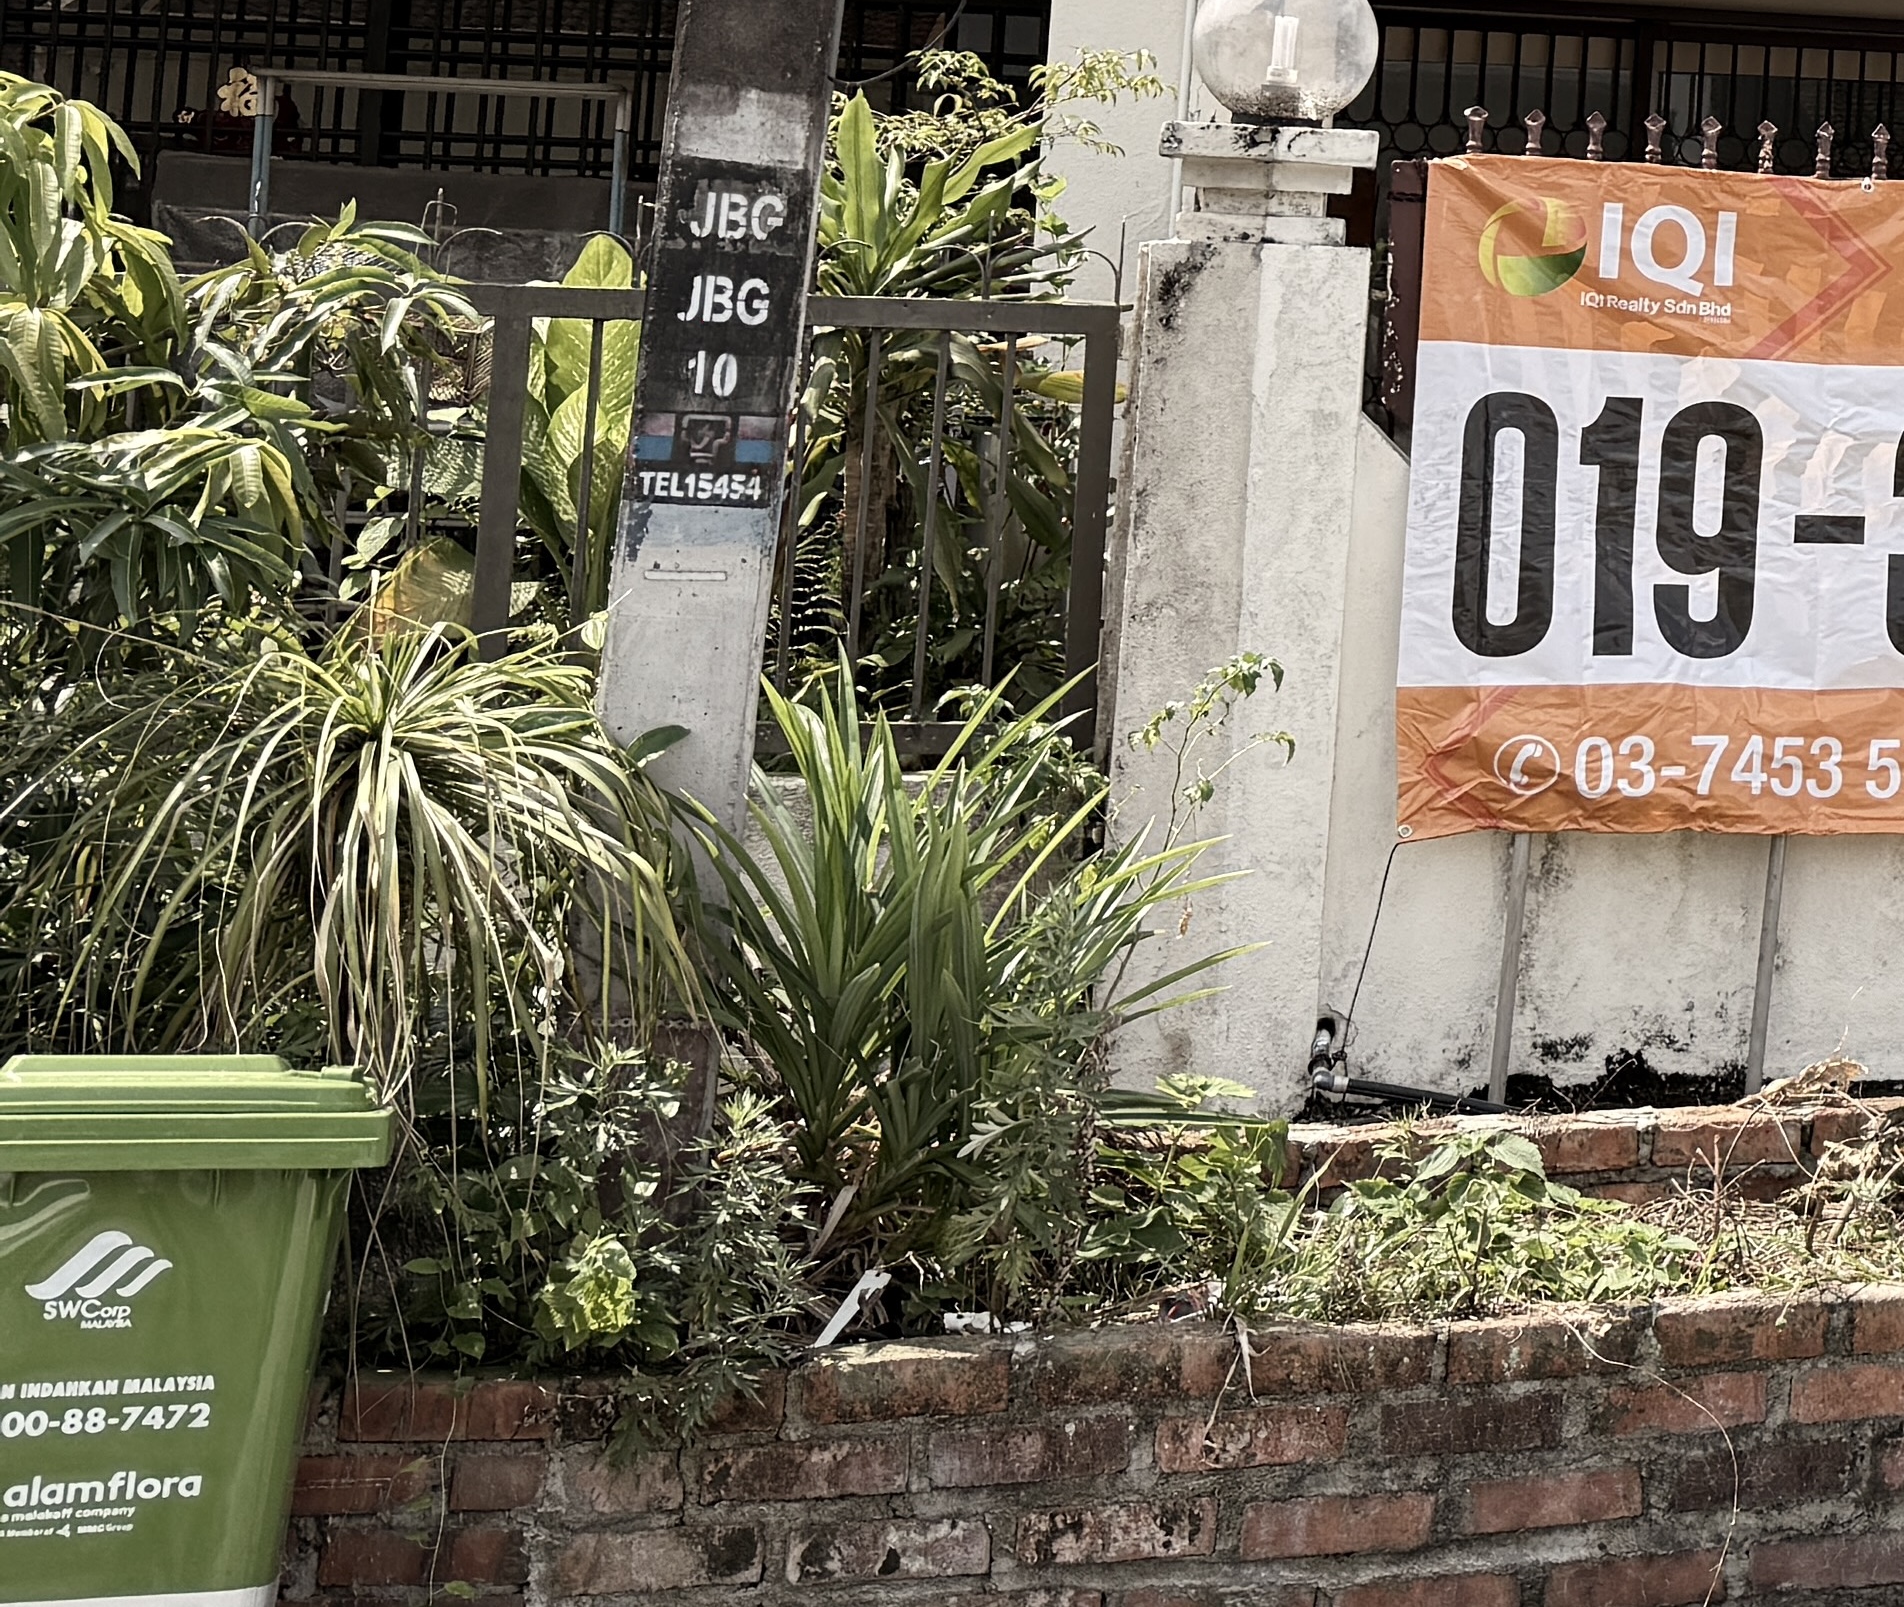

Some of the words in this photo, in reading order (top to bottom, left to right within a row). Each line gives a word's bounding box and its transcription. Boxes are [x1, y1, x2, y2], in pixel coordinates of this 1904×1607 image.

[690, 192, 784, 242] JBG
[1599, 202, 1737, 298] IQI
[677, 275, 770, 326] JBG
[1606, 295, 1660, 315] Realty
[1664, 299, 1697, 314] Sdn
[1698, 301, 1732, 317] Bhd
[687, 350, 738, 397] 10
[1574, 734, 1844, 799] 03-7453
[43, 1299, 131, 1320] SWCorp
[80, 1319, 132, 1329] MALAYSIA
[20, 1379, 119, 1398] INDAHKAN
[122, 1375, 215, 1394] MALAYSIA
[3, 1471, 203, 1508] alamflora
[75, 1506, 136, 1519] company
